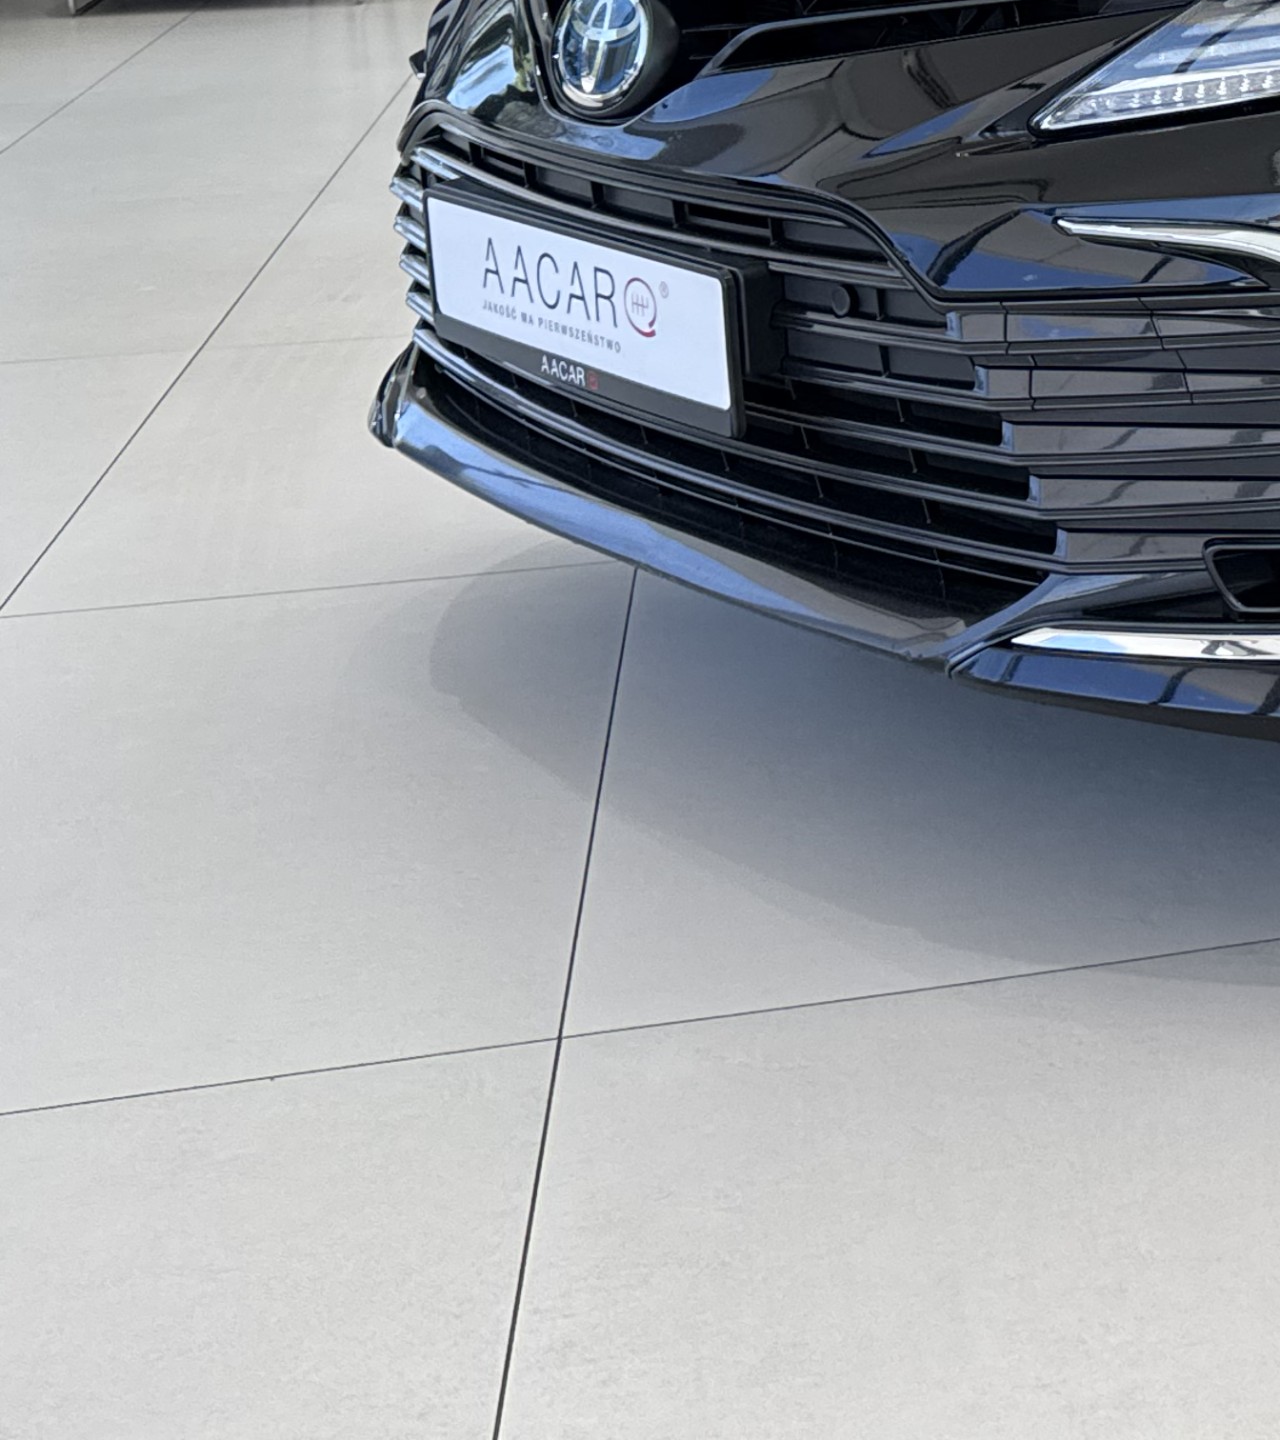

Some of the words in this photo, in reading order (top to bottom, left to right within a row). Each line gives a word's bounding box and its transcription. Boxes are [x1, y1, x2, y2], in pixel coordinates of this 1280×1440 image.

[482, 299, 517, 320] JAKOŚĆ
[520, 311, 535, 326] MA
[537, 316, 622, 354] PIERWSZEŃSTWO
